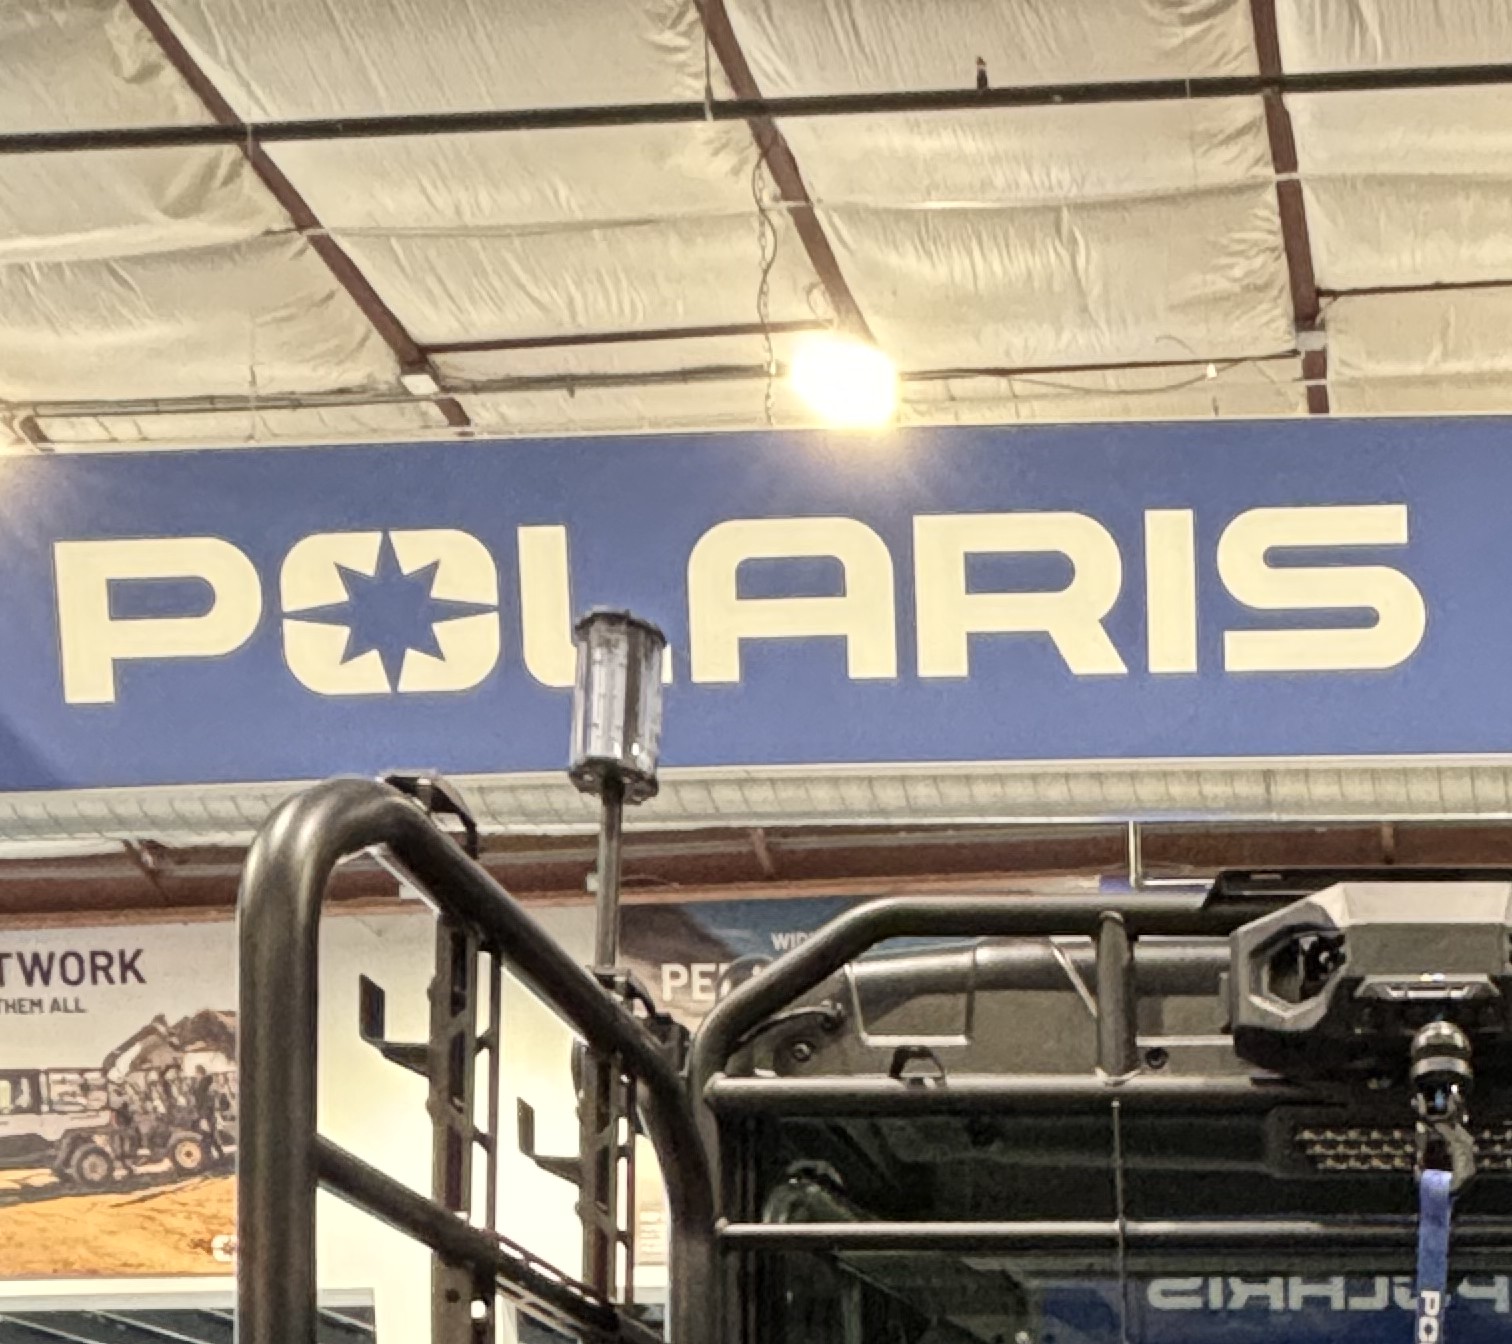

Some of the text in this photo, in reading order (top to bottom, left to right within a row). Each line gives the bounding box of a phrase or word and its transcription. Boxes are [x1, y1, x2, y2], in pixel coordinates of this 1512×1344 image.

[54, 503, 1427, 704] POLARIS
[0, 997, 87, 1014] HEM ALL
